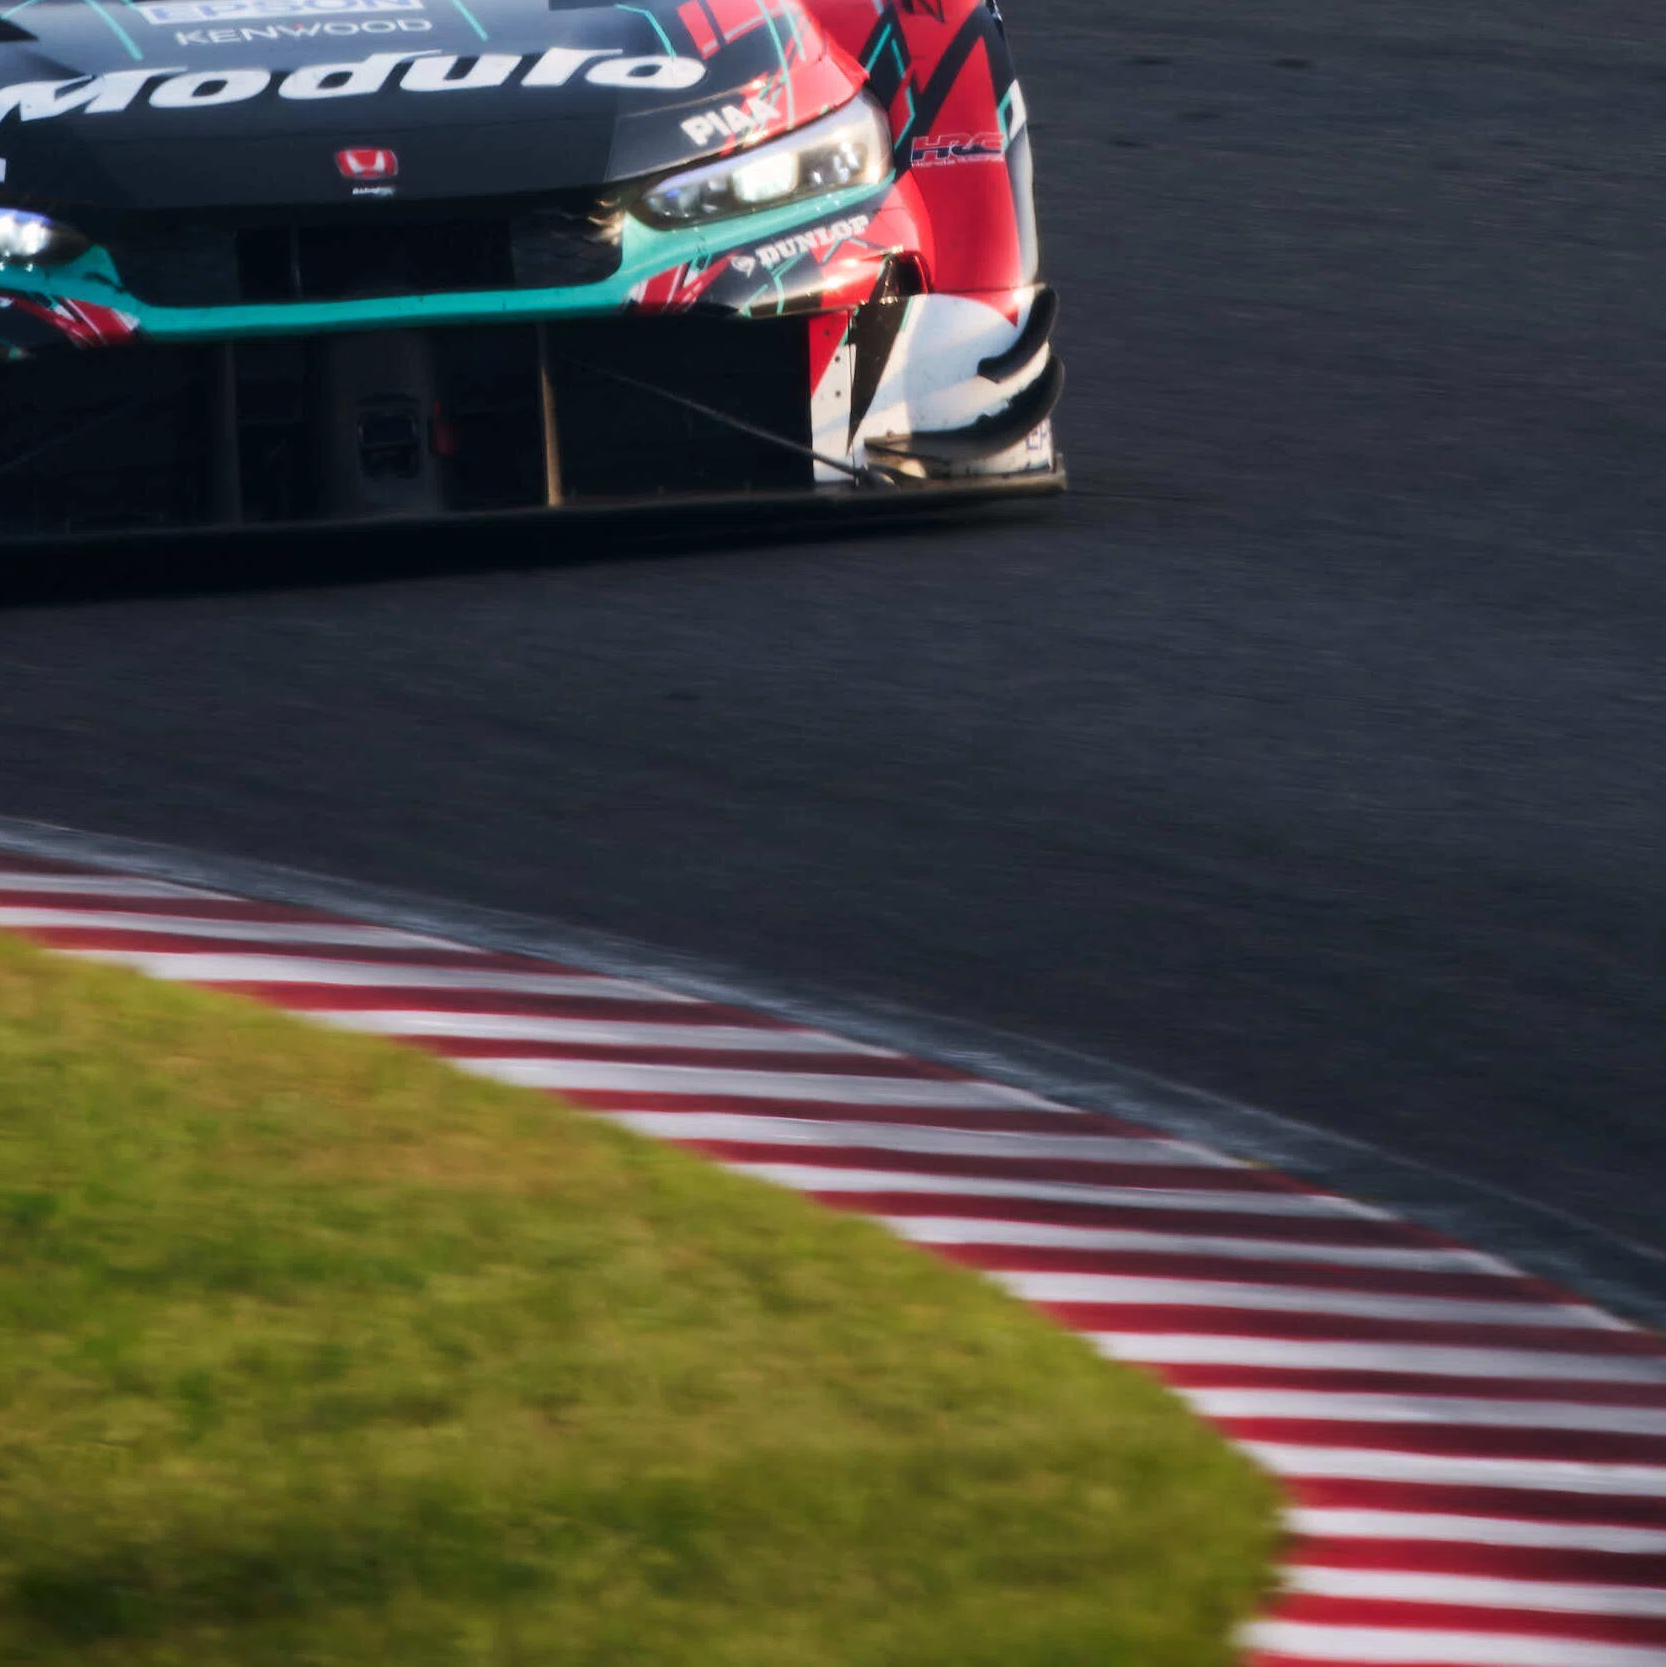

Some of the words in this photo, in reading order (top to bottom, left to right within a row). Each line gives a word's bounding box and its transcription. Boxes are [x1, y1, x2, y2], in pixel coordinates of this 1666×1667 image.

[175, 18, 433, 47] KENWOOD
[680, 97, 782, 146] PIAA
[911, 132, 1005, 162] HRC
[755, 214, 870, 265] DUNLOP
